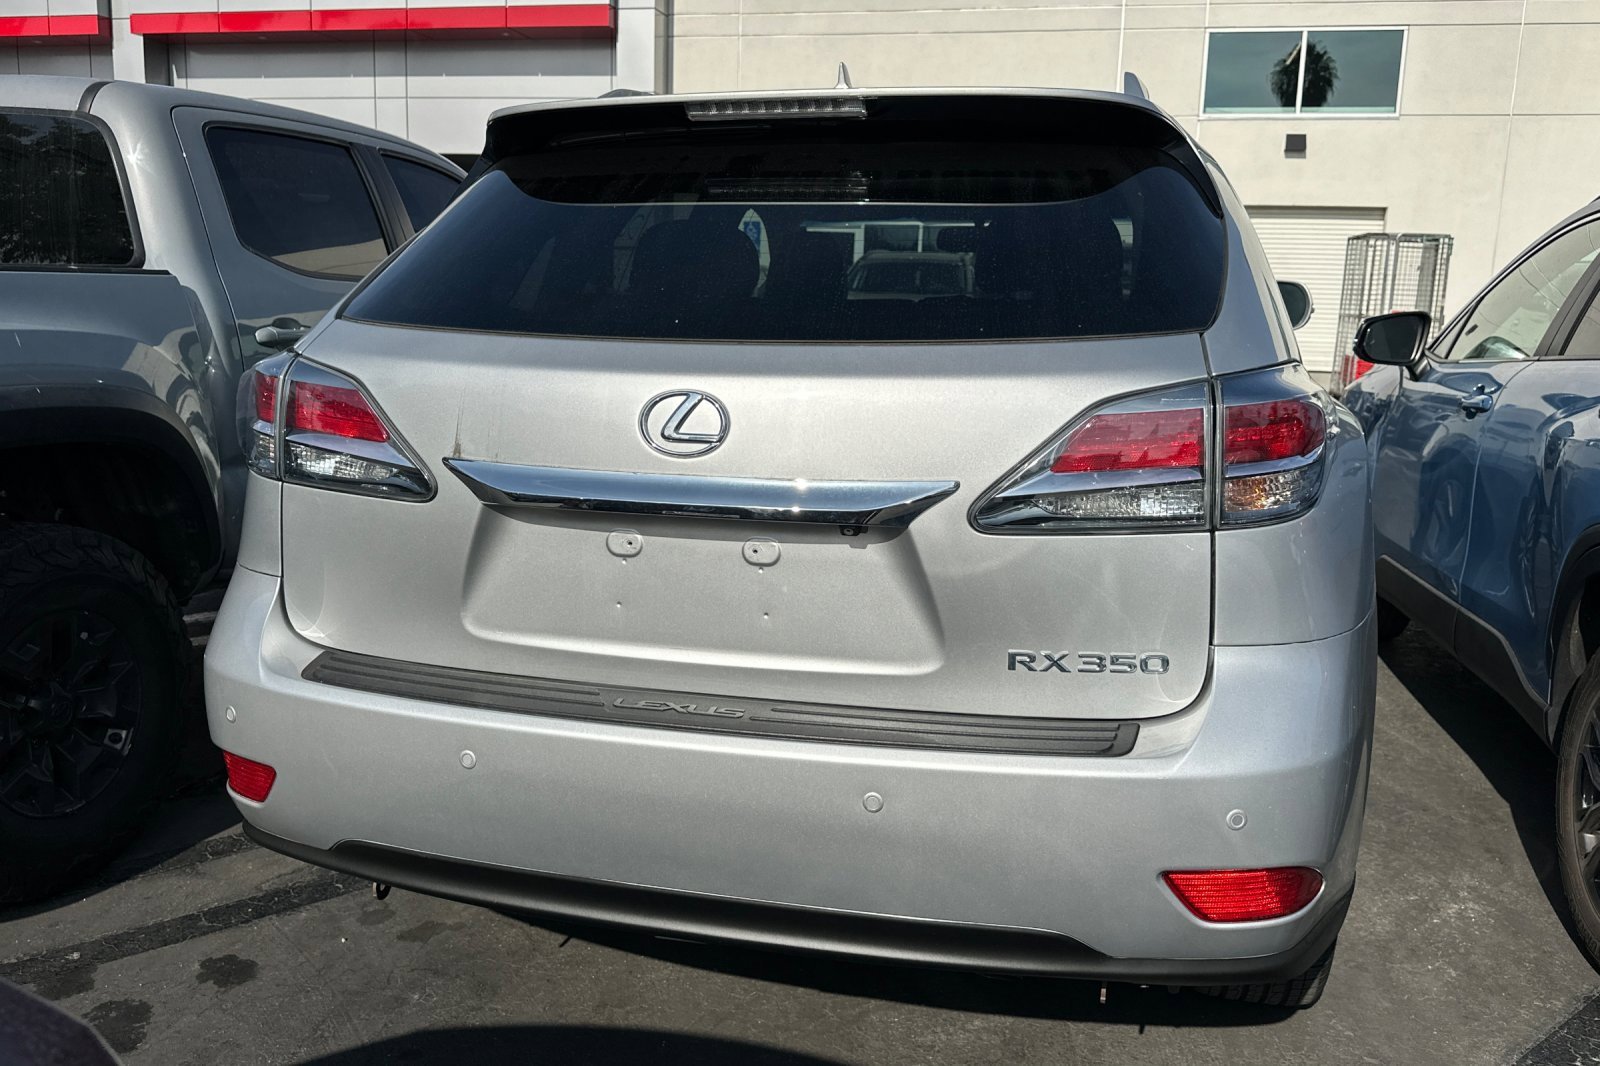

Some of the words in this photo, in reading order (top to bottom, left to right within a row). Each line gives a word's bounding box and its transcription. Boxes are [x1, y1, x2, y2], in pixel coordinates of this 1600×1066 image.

[1007, 649, 1071, 673] RX
[1077, 651, 1170, 675] 350
[612, 697, 746, 719] LEXUS
